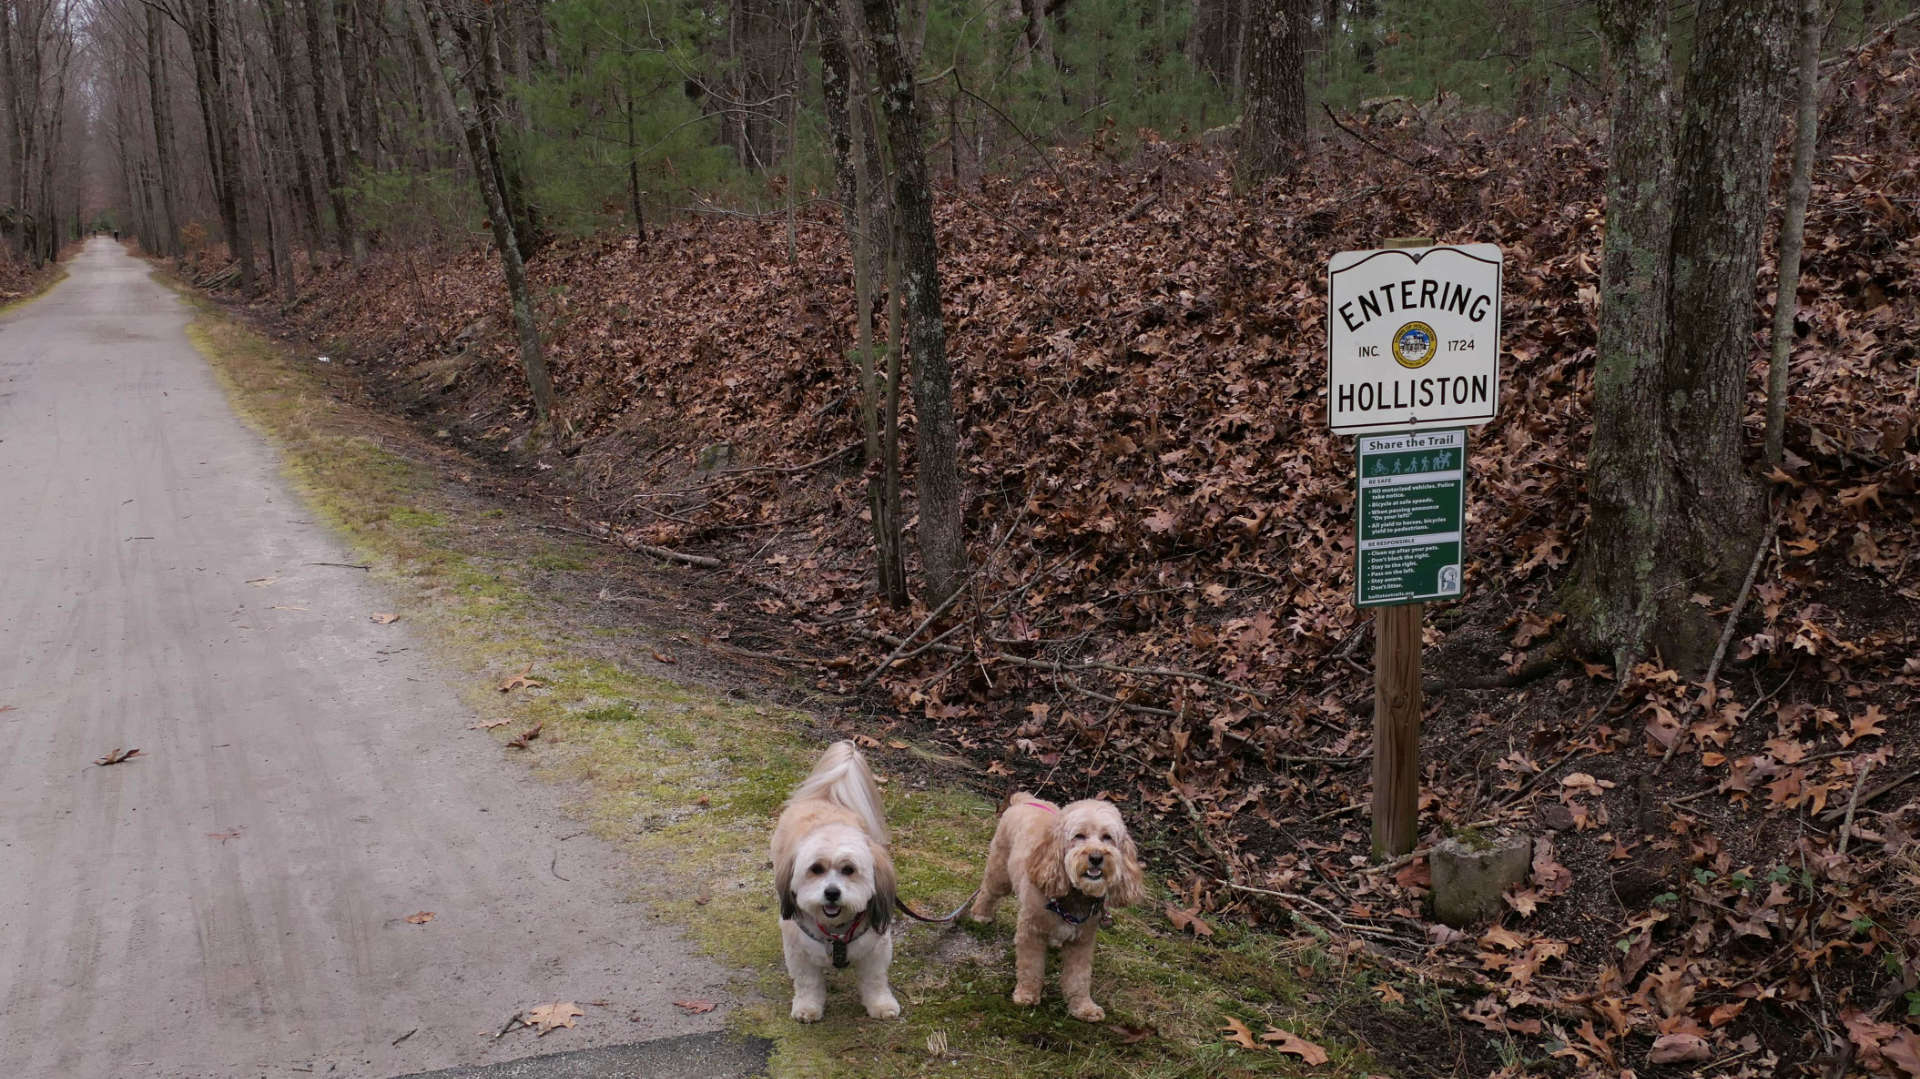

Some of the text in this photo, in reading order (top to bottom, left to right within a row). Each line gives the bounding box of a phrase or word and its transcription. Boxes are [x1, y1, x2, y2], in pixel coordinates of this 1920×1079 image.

[1338, 280, 1491, 332] ENTERING
[1448, 340, 1475, 351] 1724
[1339, 375, 1487, 412] HOLLISTON
[1369, 435, 1454, 450] Share the Trail
